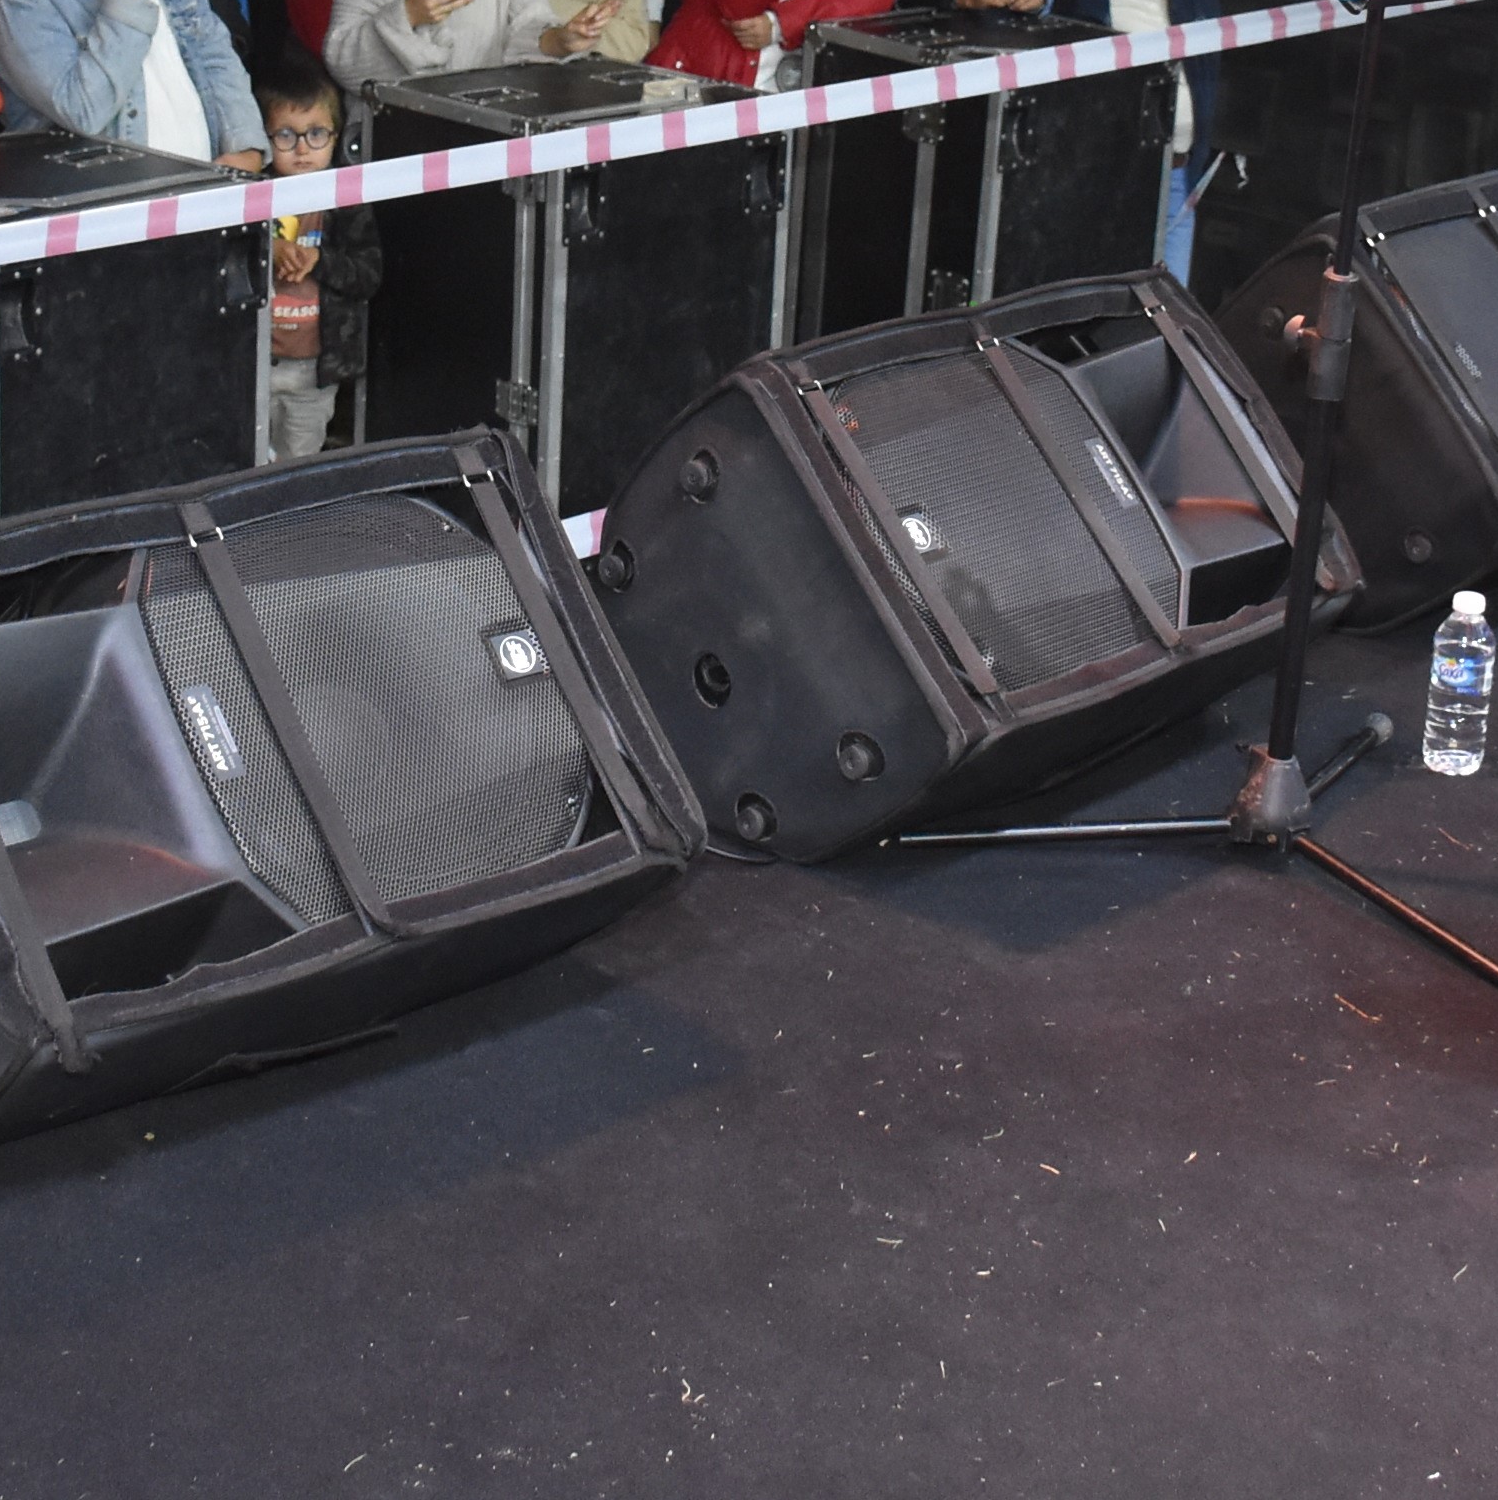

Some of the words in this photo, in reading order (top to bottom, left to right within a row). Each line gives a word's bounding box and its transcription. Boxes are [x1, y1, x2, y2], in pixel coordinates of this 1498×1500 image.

[274, 305, 320, 318] SEASO
[1095, 443, 1113, 467] ART
[207, 742, 229, 771] ART
